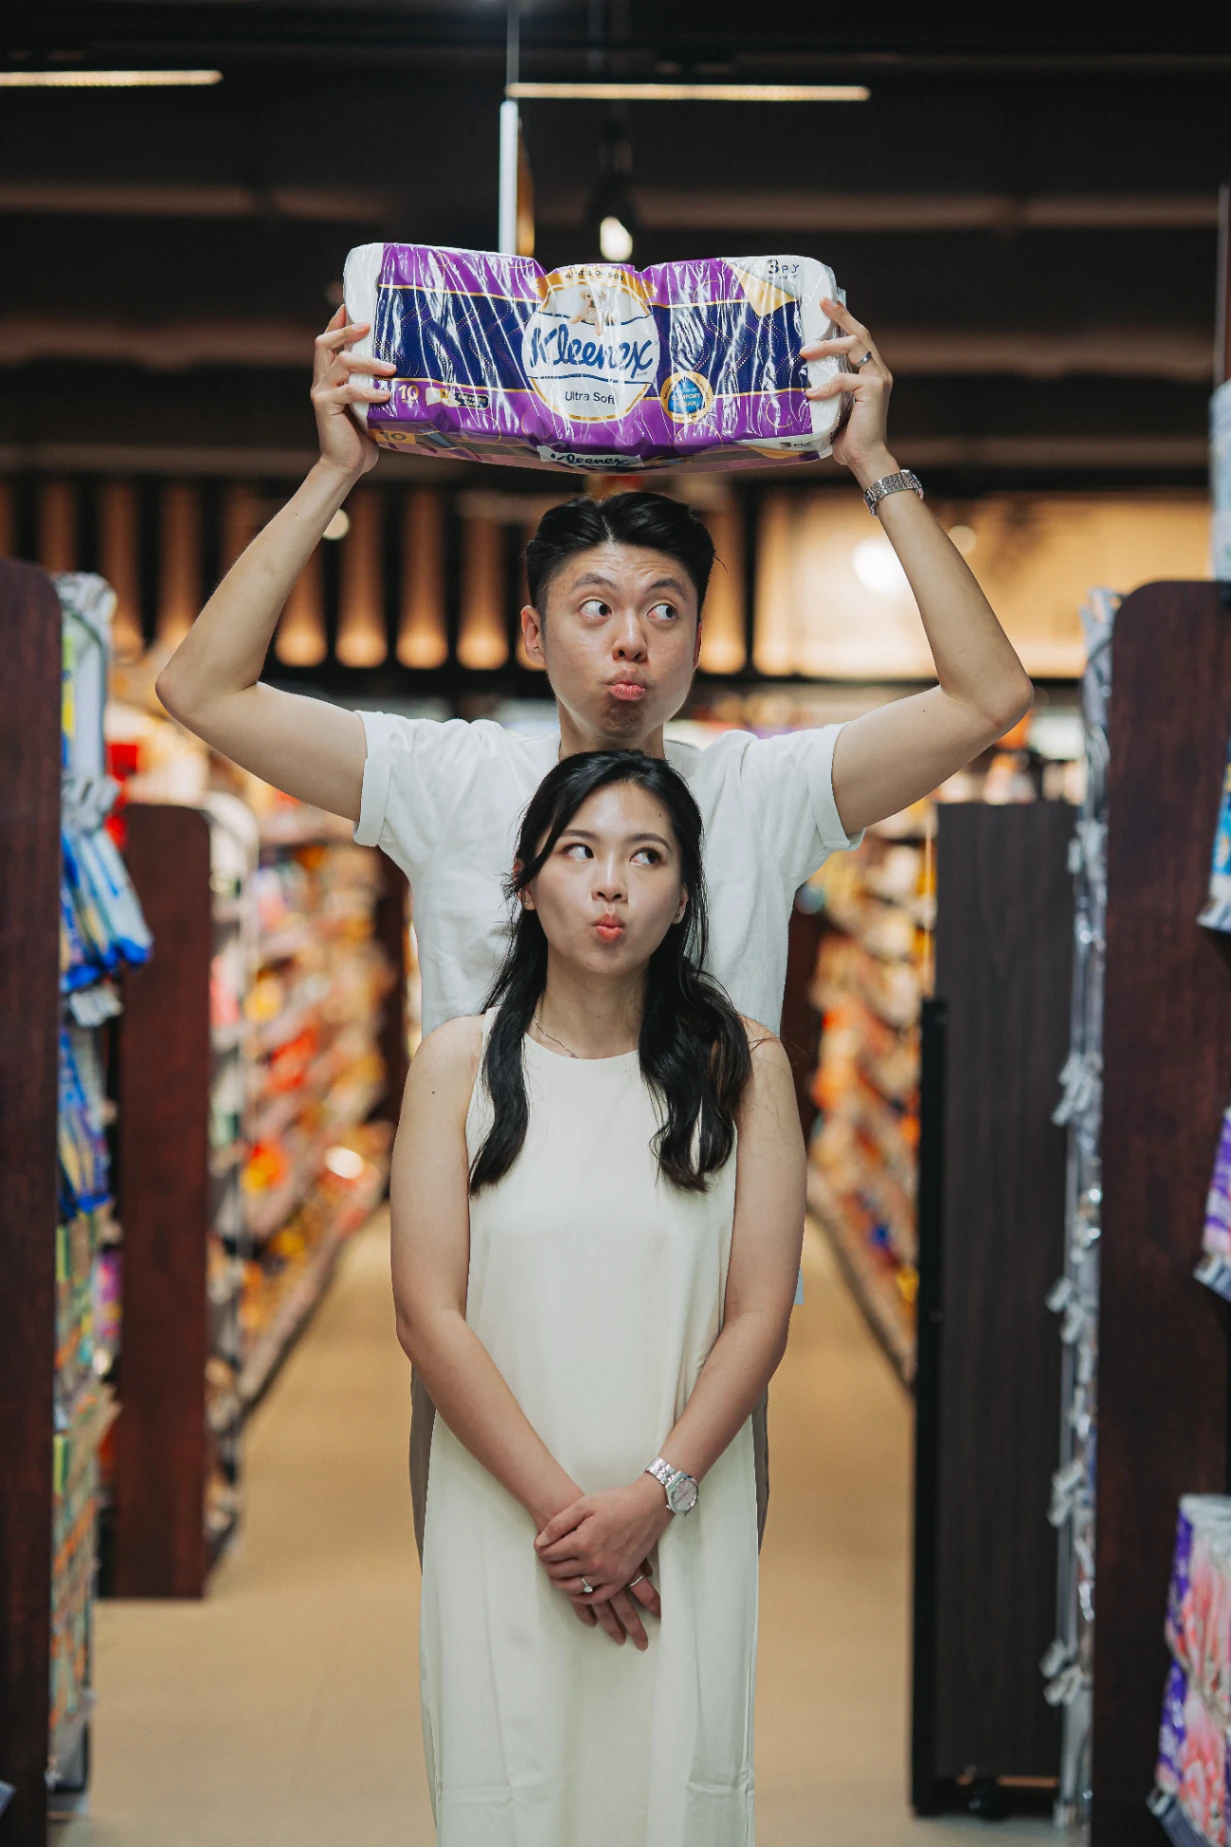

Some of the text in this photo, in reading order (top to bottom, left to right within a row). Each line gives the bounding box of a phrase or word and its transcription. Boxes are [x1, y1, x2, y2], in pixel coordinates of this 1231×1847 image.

[767, 259, 799, 274] 3 PY
[530, 324, 653, 379] Kleenex
[399, 384, 419, 401] 10
[565, 391, 615, 405] Ultra Soft
